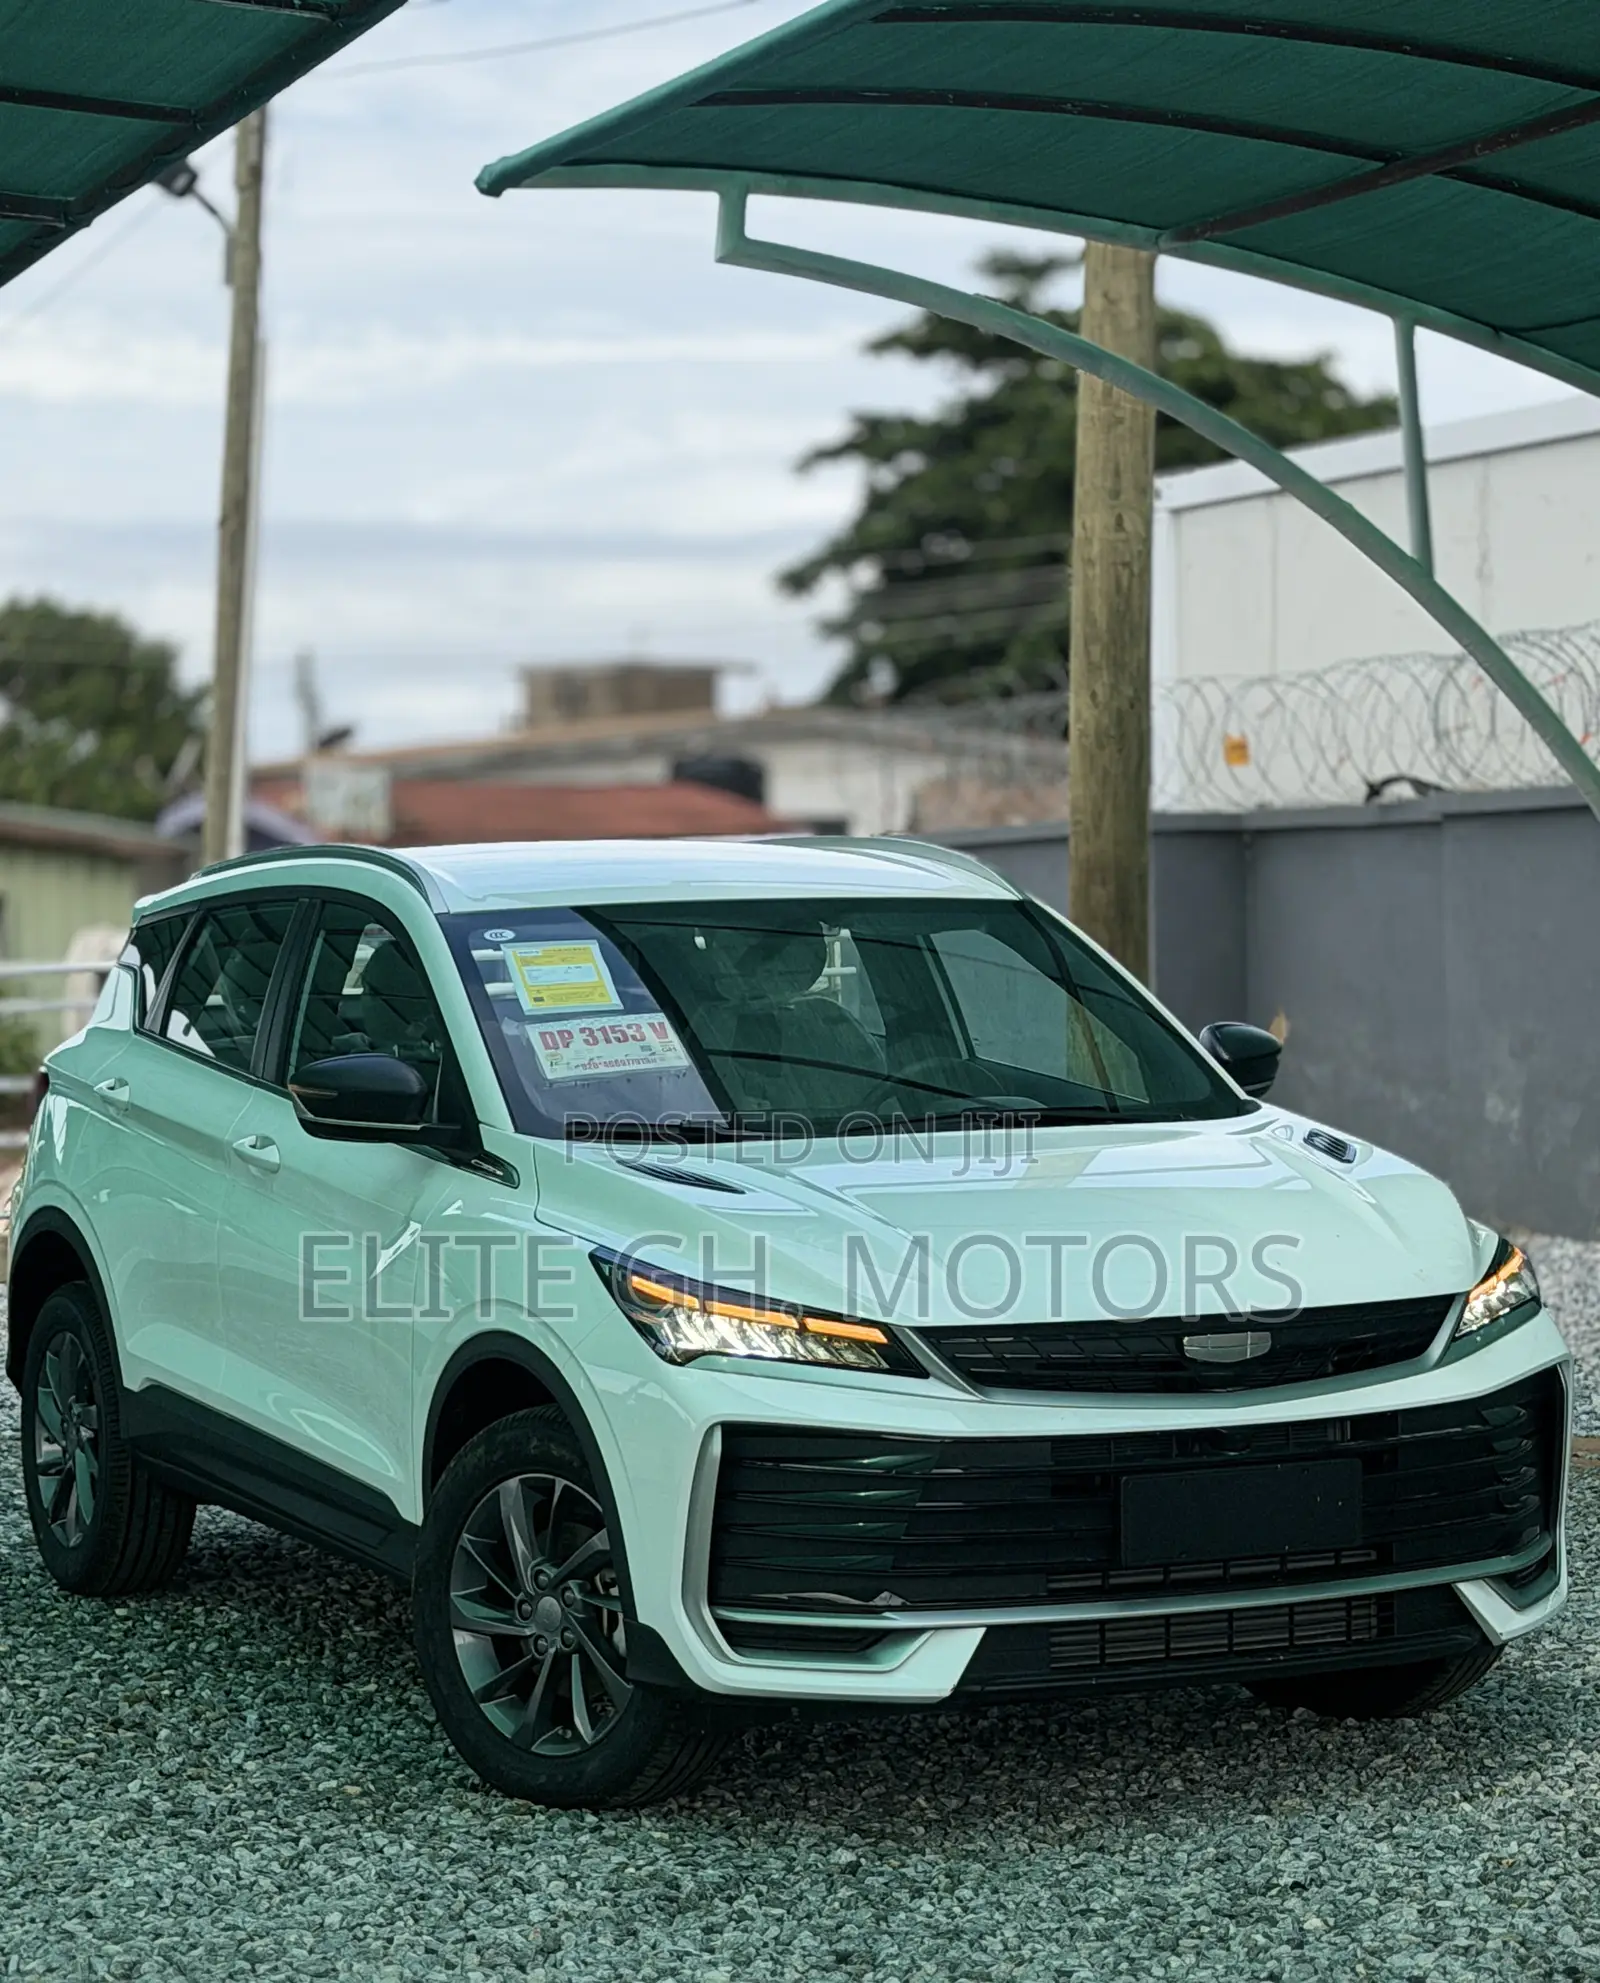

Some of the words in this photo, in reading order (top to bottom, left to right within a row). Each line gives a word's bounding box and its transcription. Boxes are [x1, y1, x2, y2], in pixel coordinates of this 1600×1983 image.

[538, 1029, 574, 1051] DP
[579, 1023, 647, 1047] 3153
[647, 1021, 669, 1040] V
